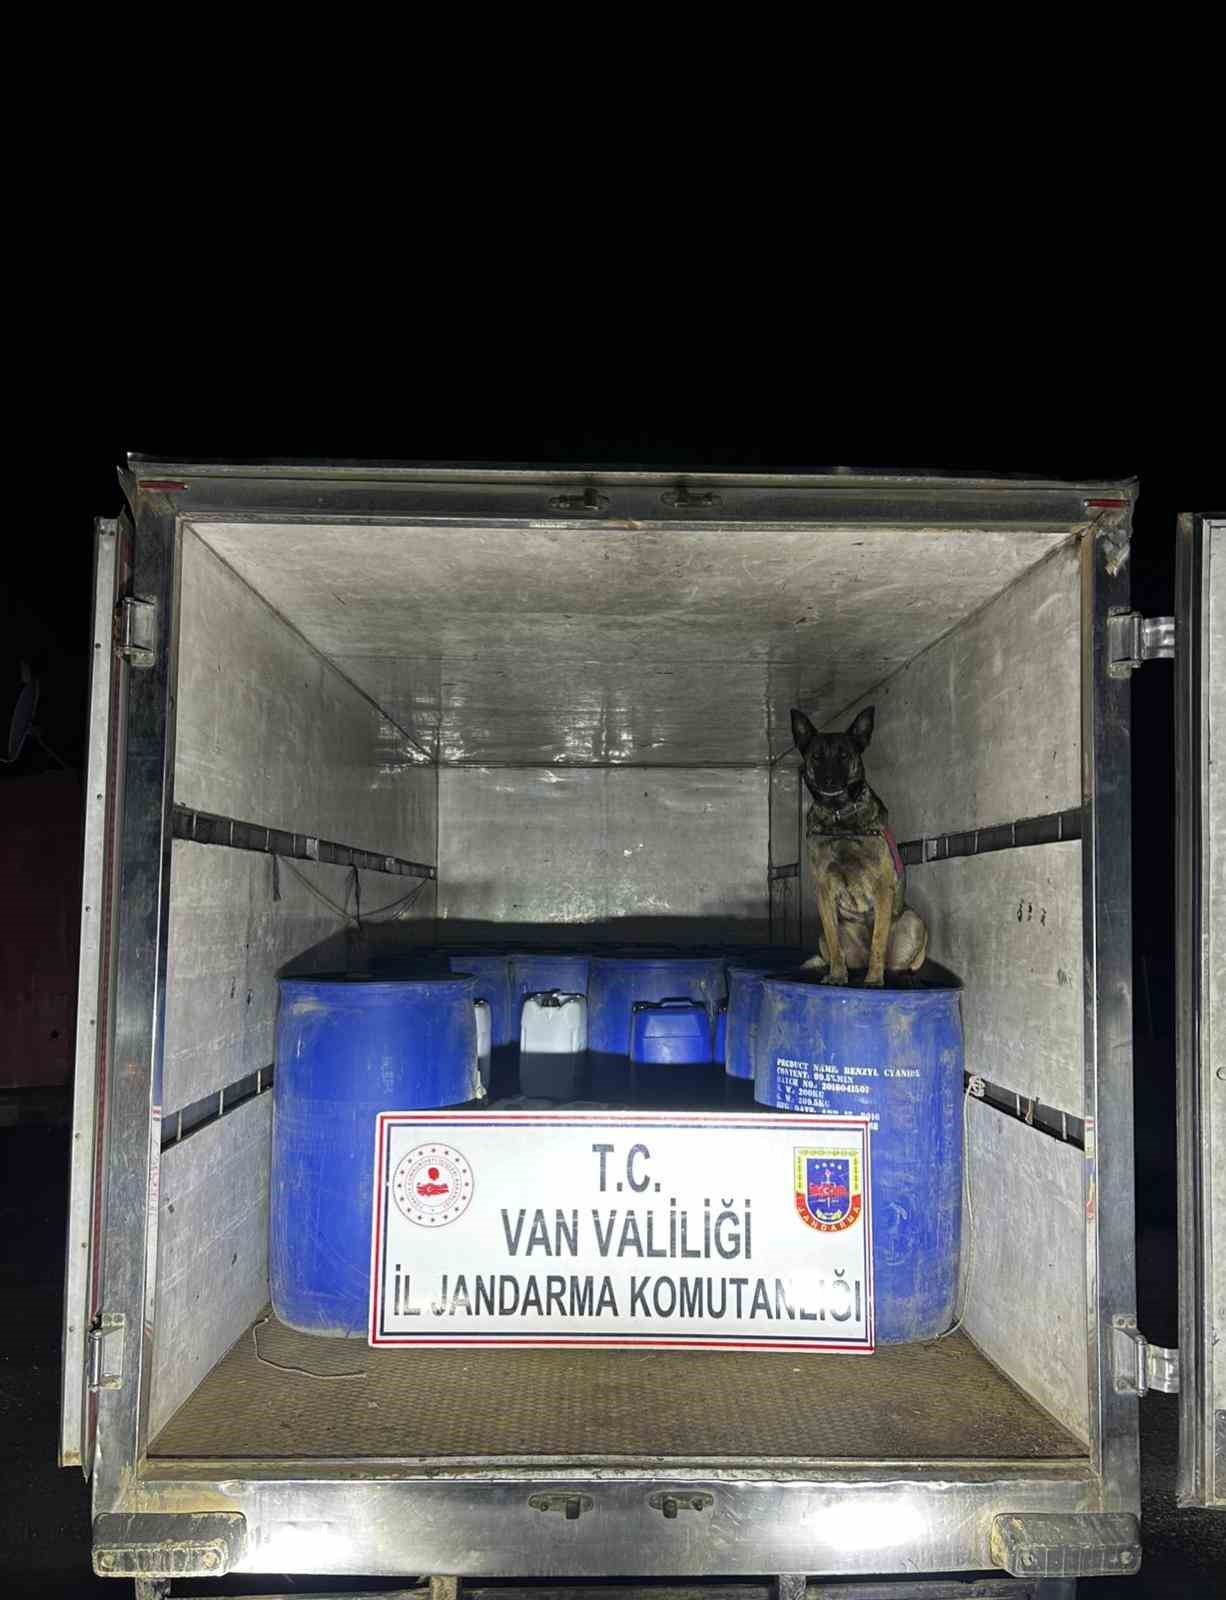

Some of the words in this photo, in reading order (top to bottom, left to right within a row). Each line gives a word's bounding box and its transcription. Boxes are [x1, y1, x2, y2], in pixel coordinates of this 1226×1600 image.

[777, 1058, 808, 1070] PRODUCT
[844, 1066, 879, 1077] BENZYL
[592, 1143, 660, 1192] T.C.
[501, 1208, 578, 1257] VAN
[592, 1198, 751, 1259] VALİLİĞİ
[394, 1264, 421, 1316] İL
[431, 1274, 619, 1318] JANDARMA
